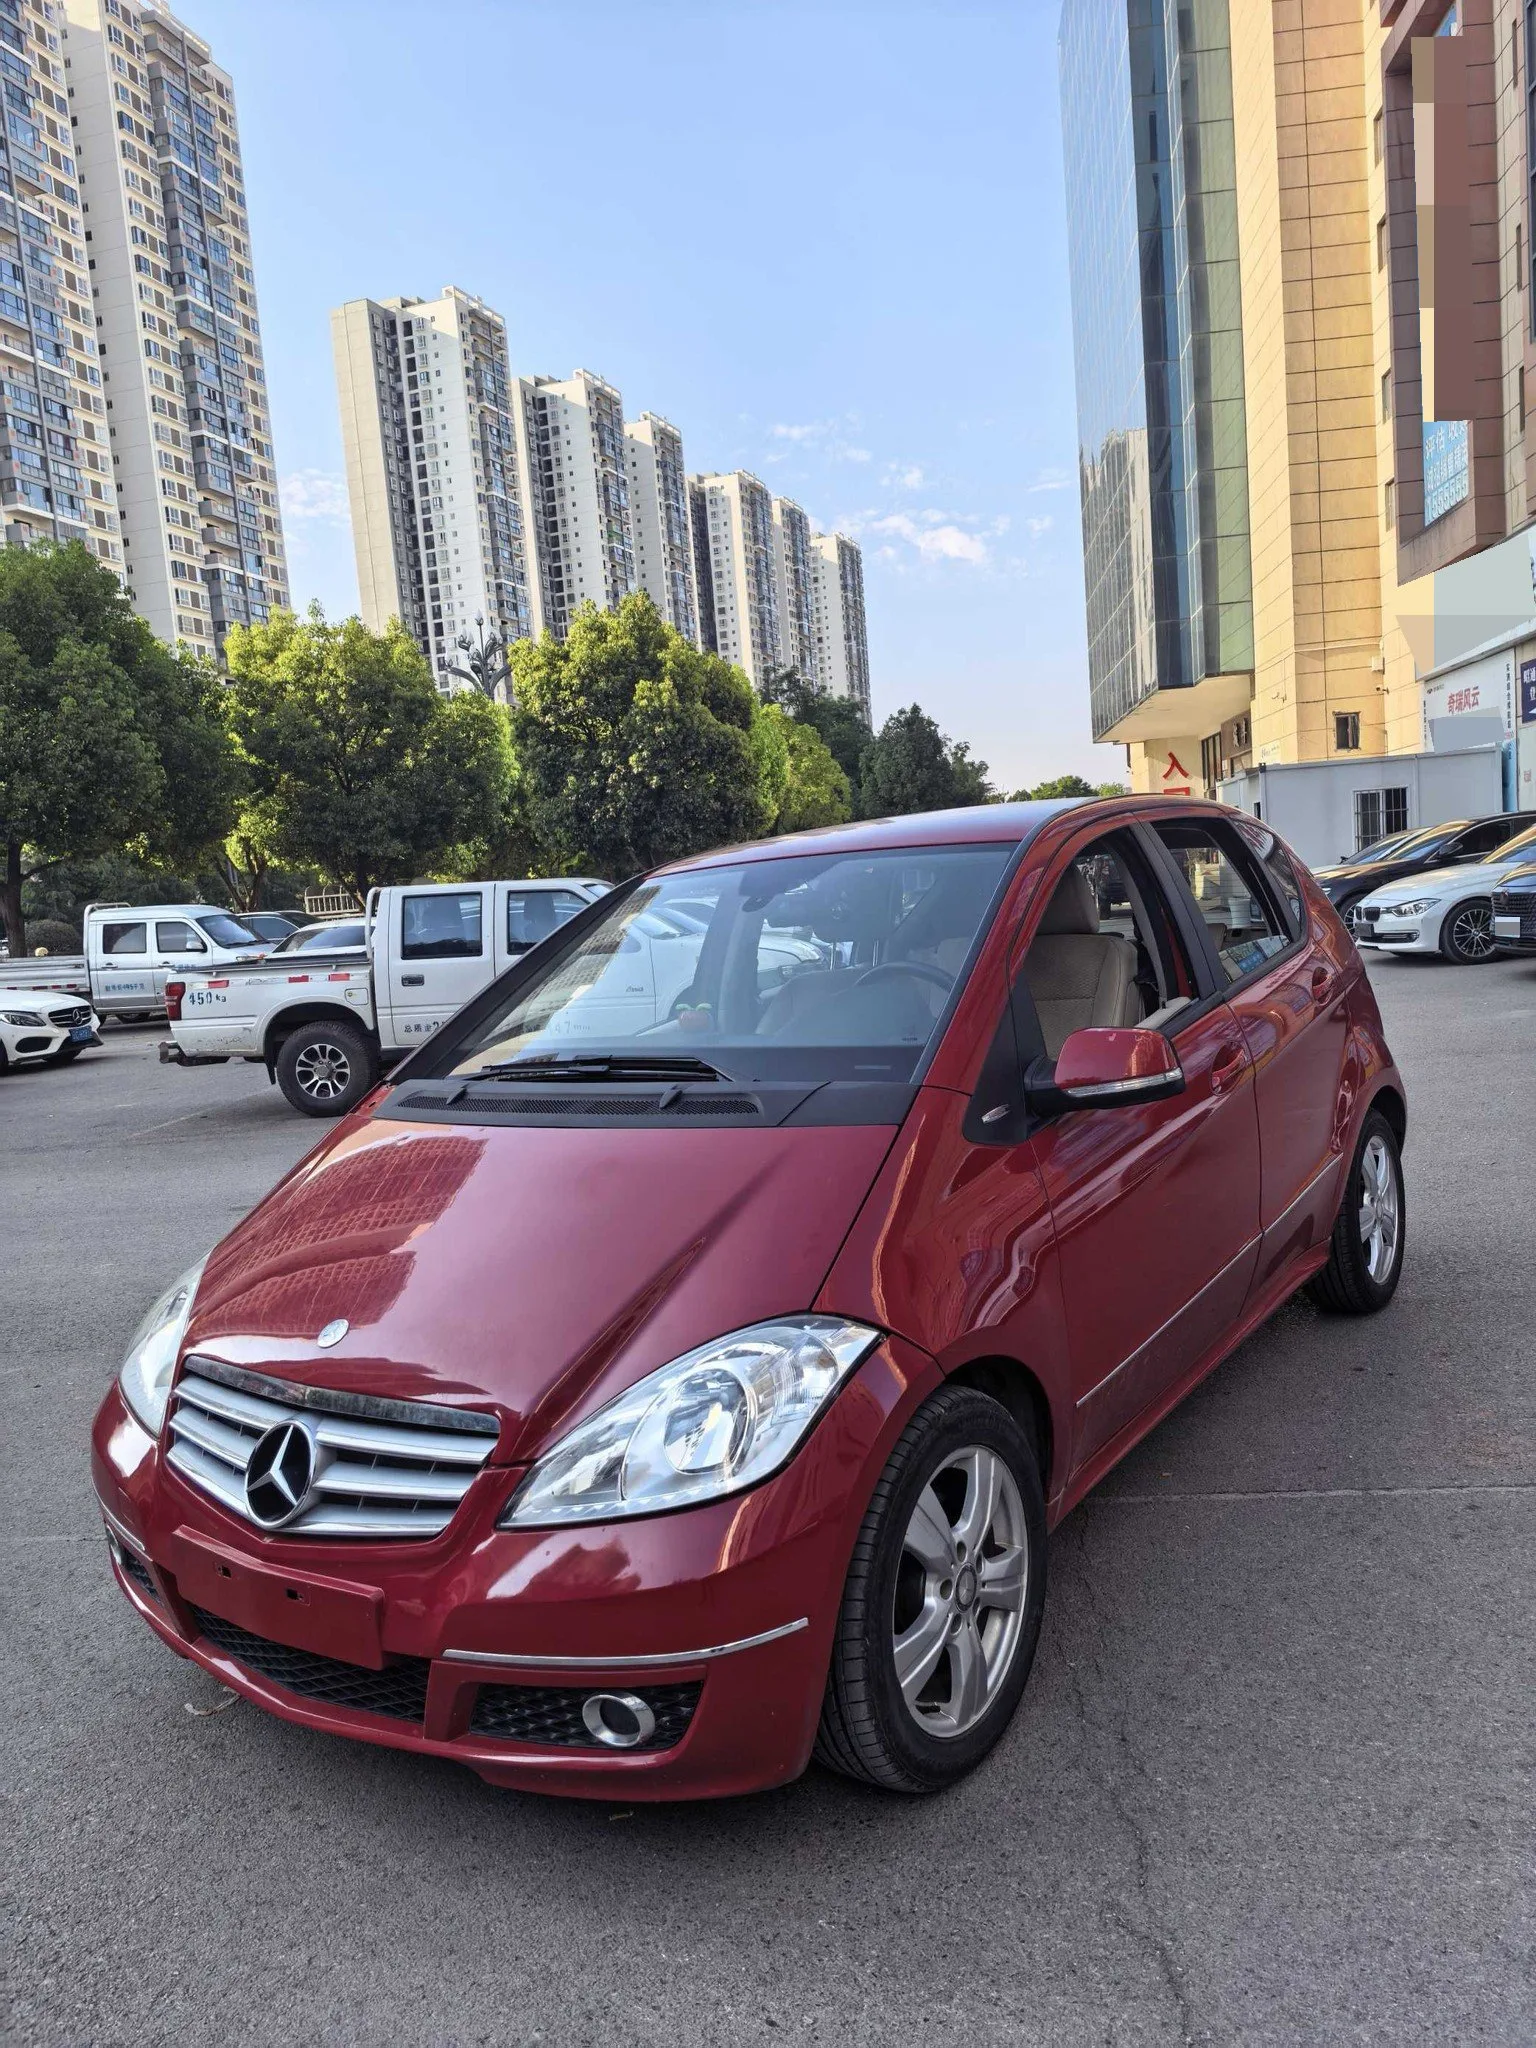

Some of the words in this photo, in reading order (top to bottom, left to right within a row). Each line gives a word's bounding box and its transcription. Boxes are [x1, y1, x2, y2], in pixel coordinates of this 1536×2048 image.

[1447, 685, 1480, 714] 奇瑞风云
[188, 991, 213, 1006] 450
